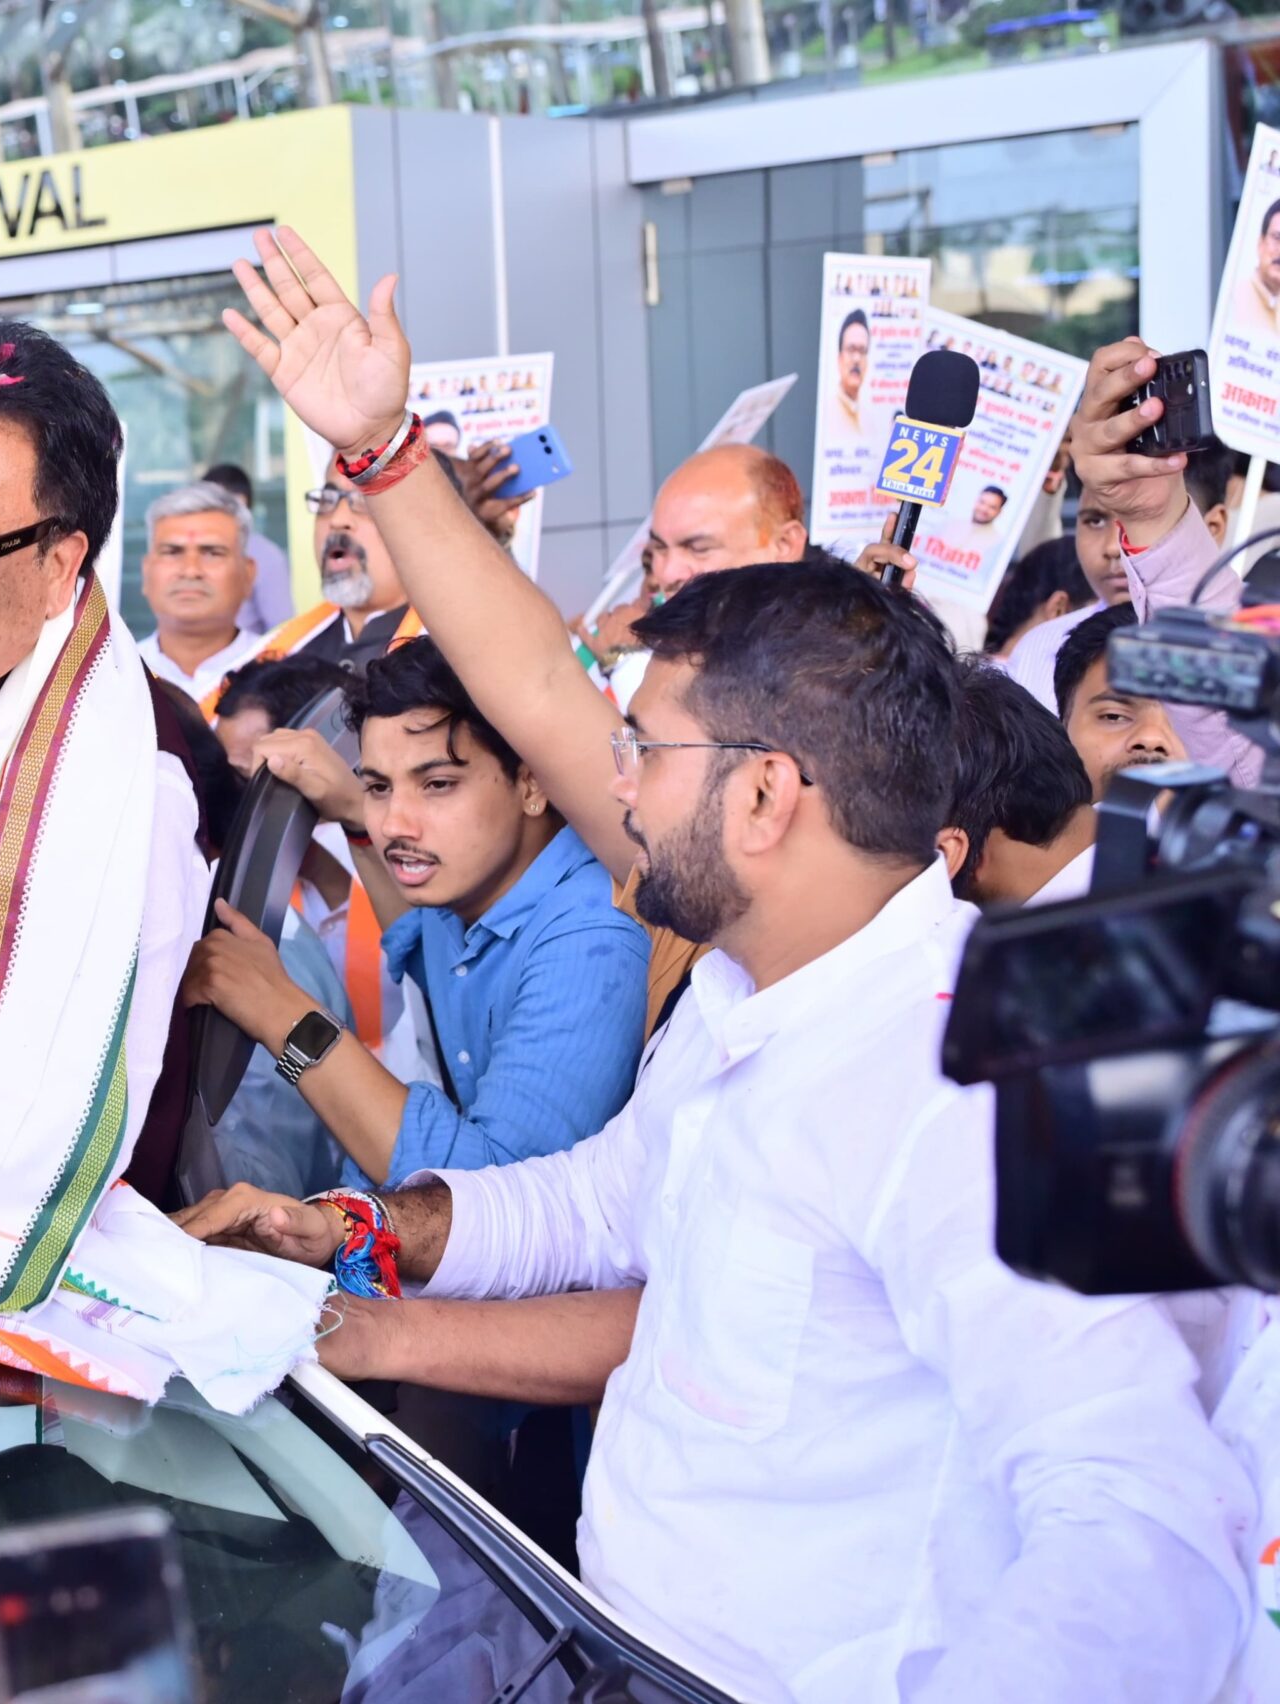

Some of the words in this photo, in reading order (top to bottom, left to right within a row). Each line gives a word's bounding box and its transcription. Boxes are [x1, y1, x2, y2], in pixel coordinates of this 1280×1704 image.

[898, 425, 950, 447] NEWS
[883, 440, 943, 488] 24
[883, 479, 908, 493] Think
[911, 487, 935, 499] First
